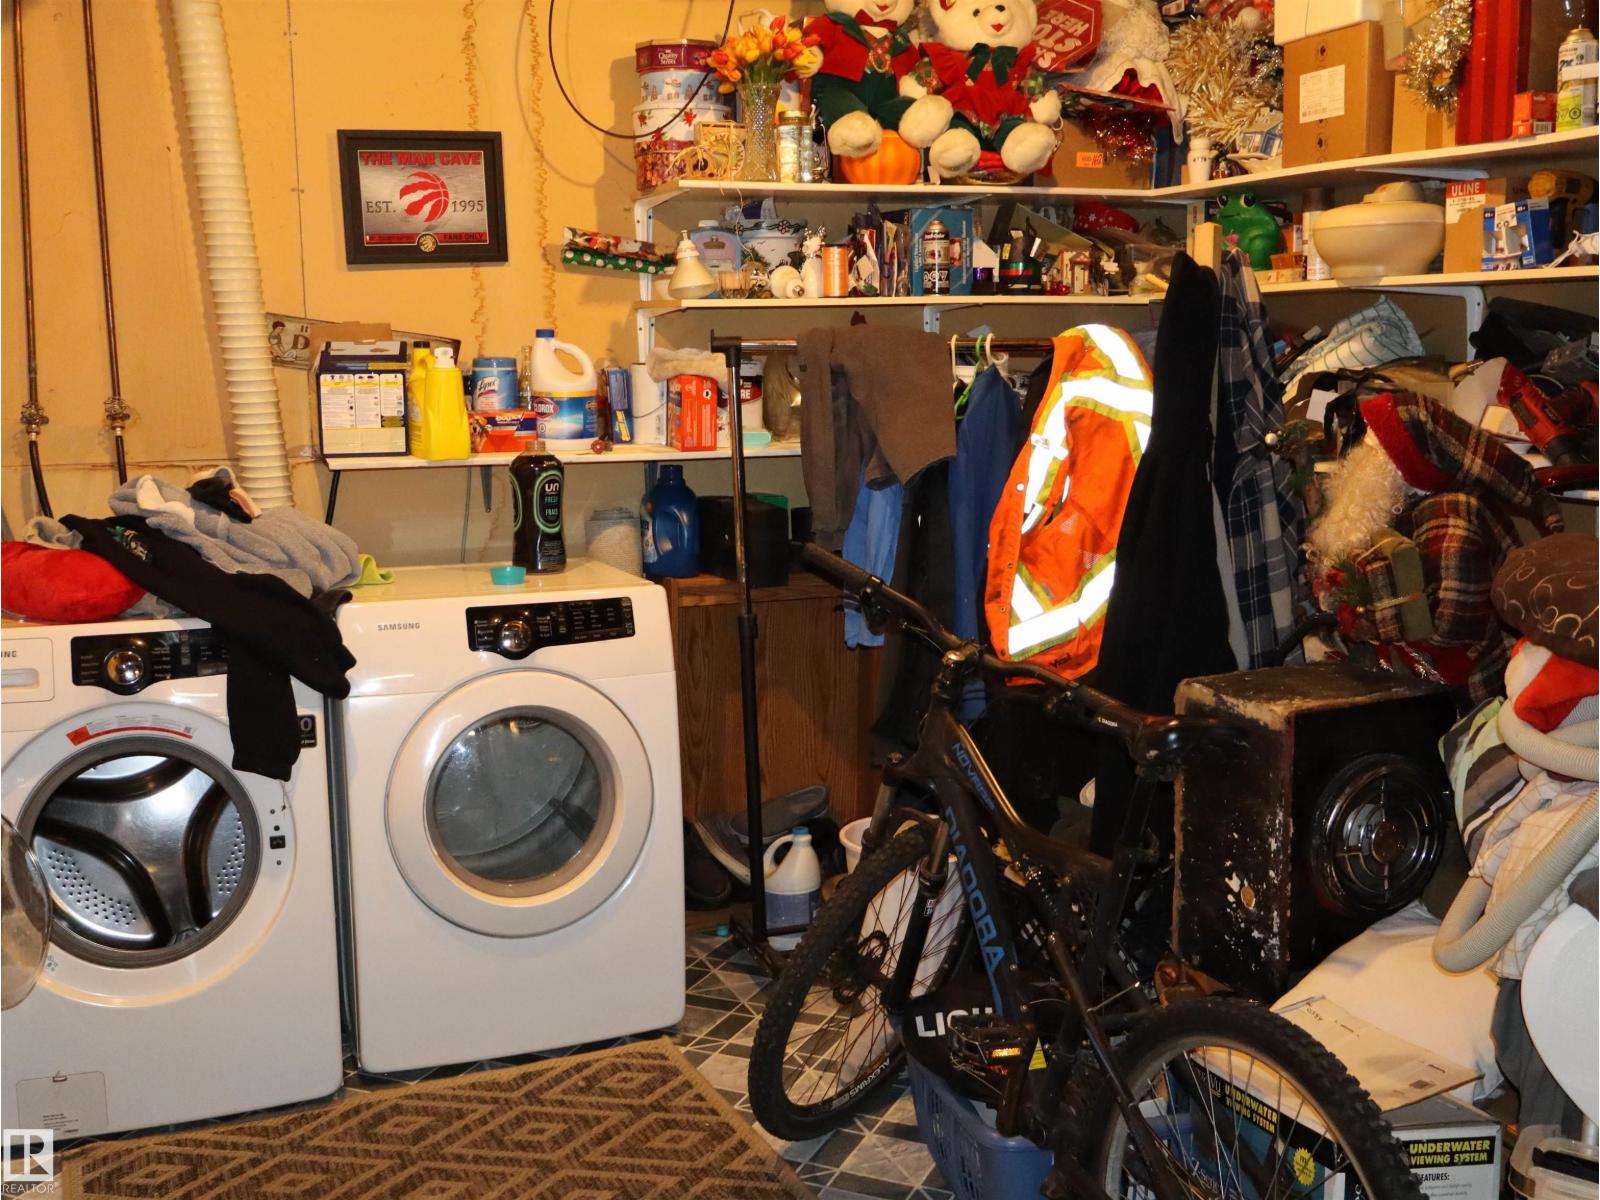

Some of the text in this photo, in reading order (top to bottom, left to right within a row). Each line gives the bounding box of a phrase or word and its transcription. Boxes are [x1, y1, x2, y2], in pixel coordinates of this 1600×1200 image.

[1032, 23, 1082, 52] STO
[361, 152, 482, 166] THE MAN CAVE
[1451, 182, 1481, 197] ULINE
[366, 199, 485, 214] EST. 1995
[443, 232, 483, 241] FANS ONLY
[377, 622, 421, 632] SAMSUNG
[1409, 1140, 1491, 1154] UNDERWATER
[1410, 1152, 1488, 1166] VIEWING SYSTEM
